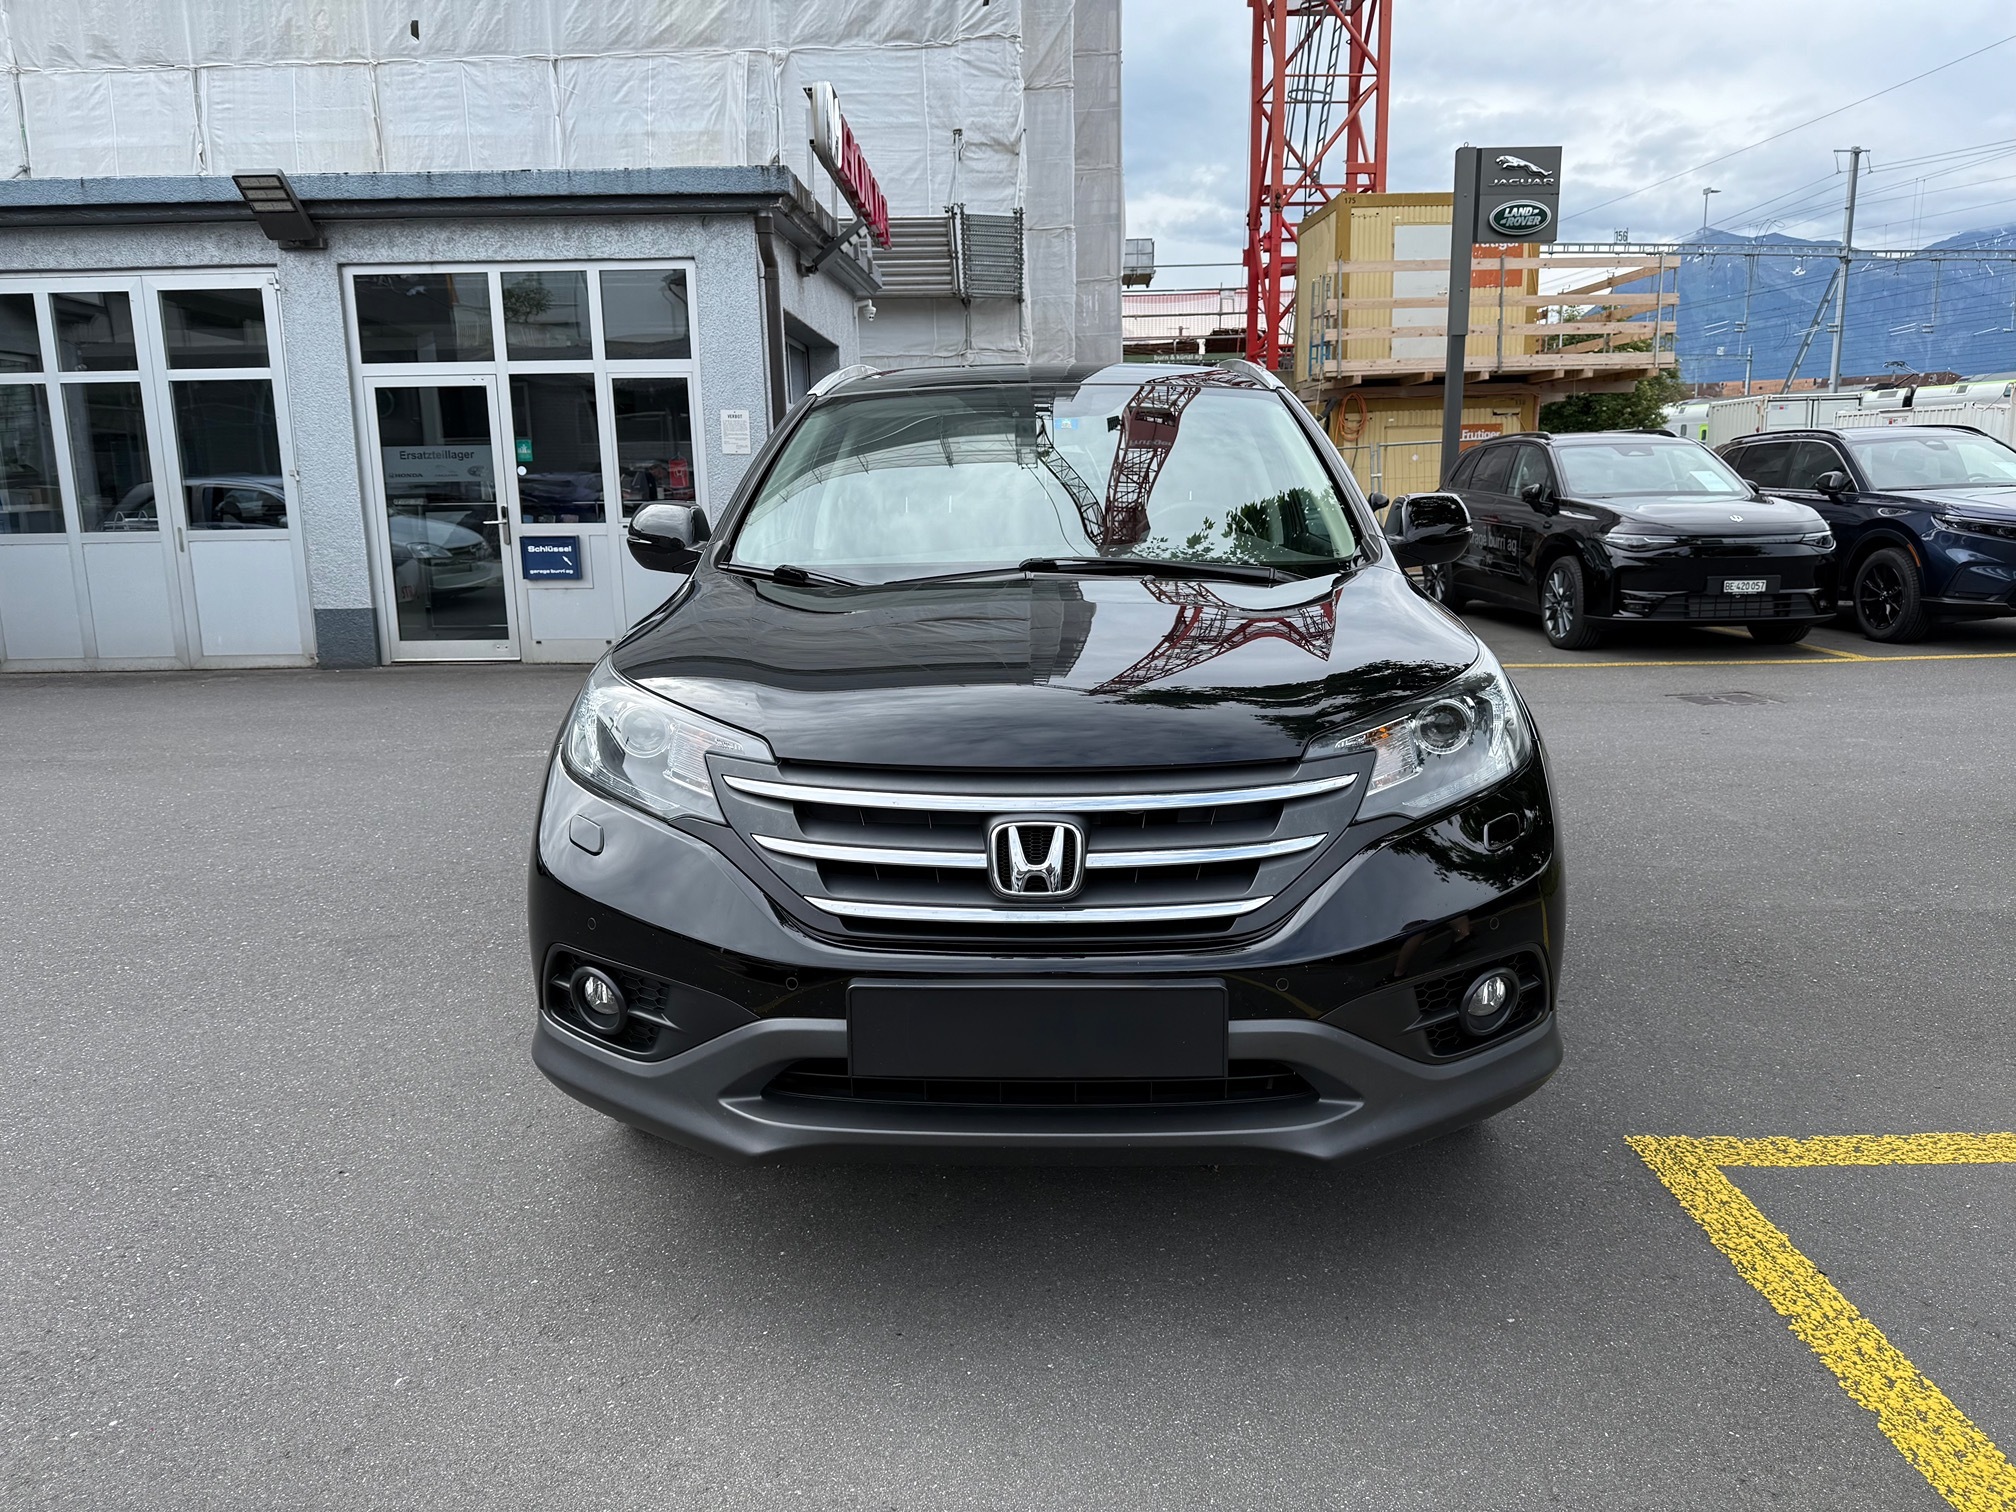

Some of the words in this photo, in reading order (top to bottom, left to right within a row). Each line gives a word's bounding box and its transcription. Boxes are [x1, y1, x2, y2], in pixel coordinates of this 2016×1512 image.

[1488, 178, 1554, 187] JAGUAR
[1344, 196, 1357, 204] 175
[1504, 207, 1534, 218] LAND
[1505, 216, 1541, 227] ROVER
[1615, 230, 1628, 242] 156
[399, 449, 475, 461] Ersatzteillager
[527, 545, 572, 553] Schlüssel
[1470, 532, 1487, 549] rage
[1506, 538, 1518, 557] ag
[1725, 582, 1735, 591] BE
